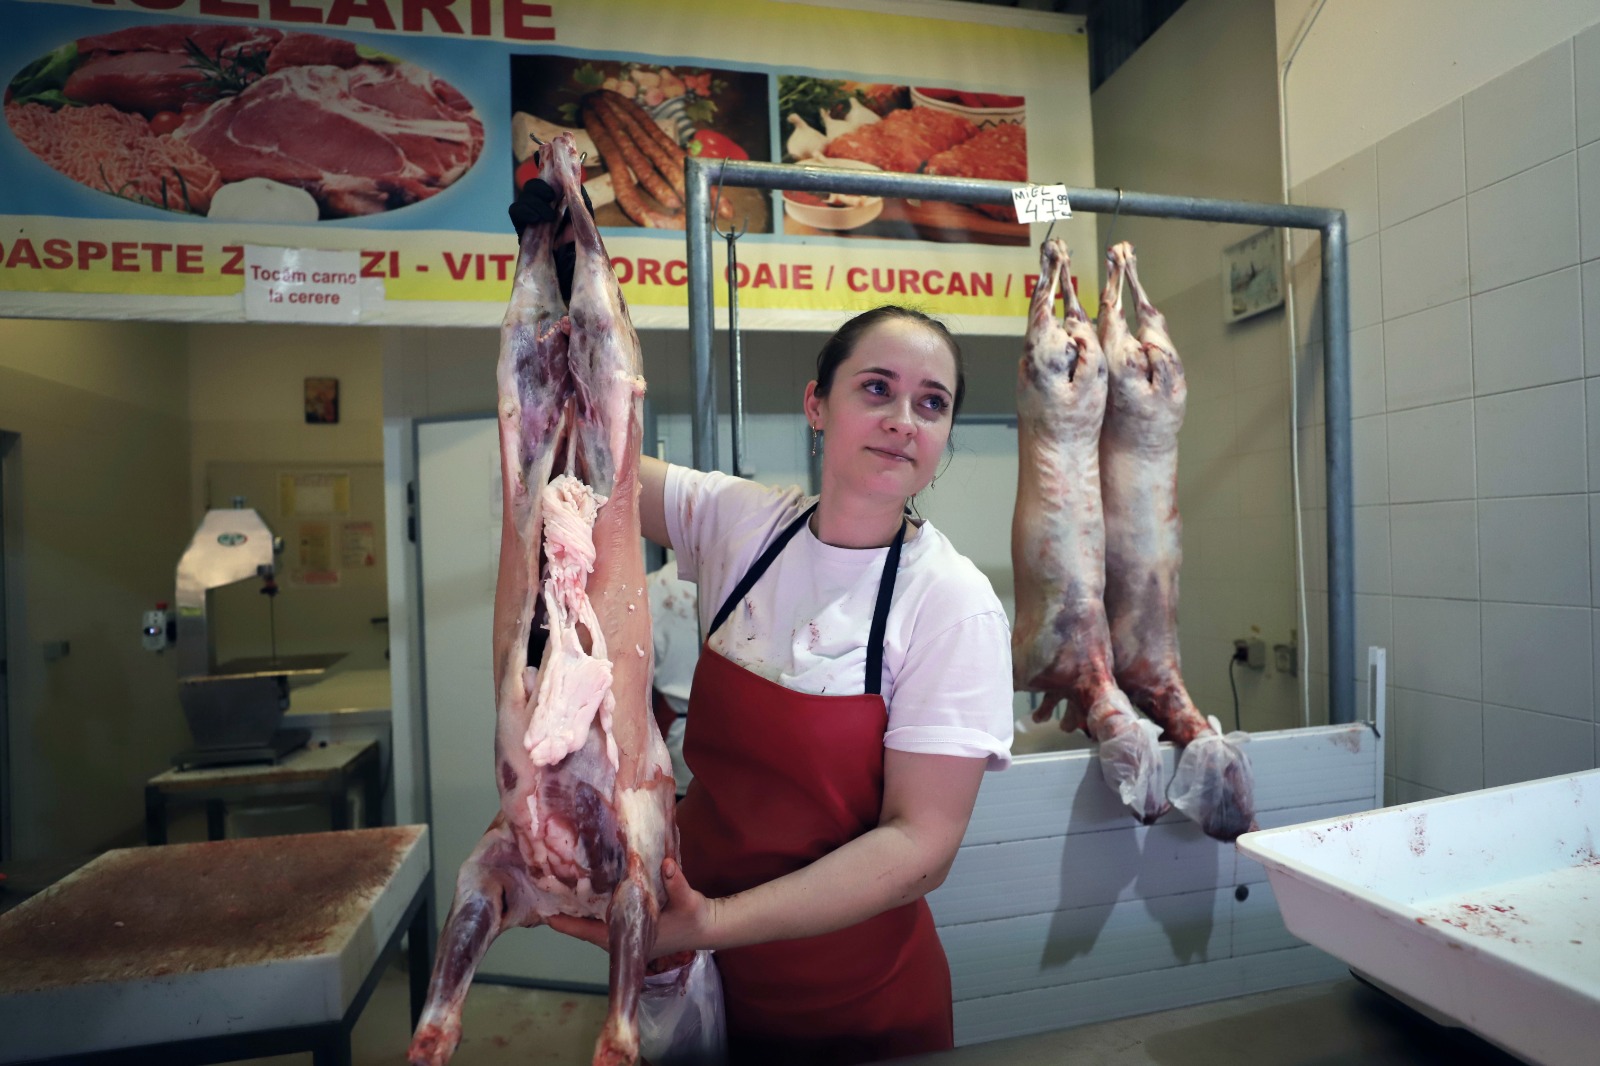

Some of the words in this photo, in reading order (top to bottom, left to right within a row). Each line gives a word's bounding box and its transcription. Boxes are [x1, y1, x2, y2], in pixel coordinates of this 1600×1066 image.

[0, 238, 205, 274] ASPETE
[360, 250, 401, 279] ZI
[442, 252, 514, 281] VIT
[610, 256, 689, 287] ORC
[724, 262, 814, 291] OAIE
[846, 267, 994, 297] CURCAN
[311, 272, 357, 285] carne
[288, 292, 341, 305] cerere
